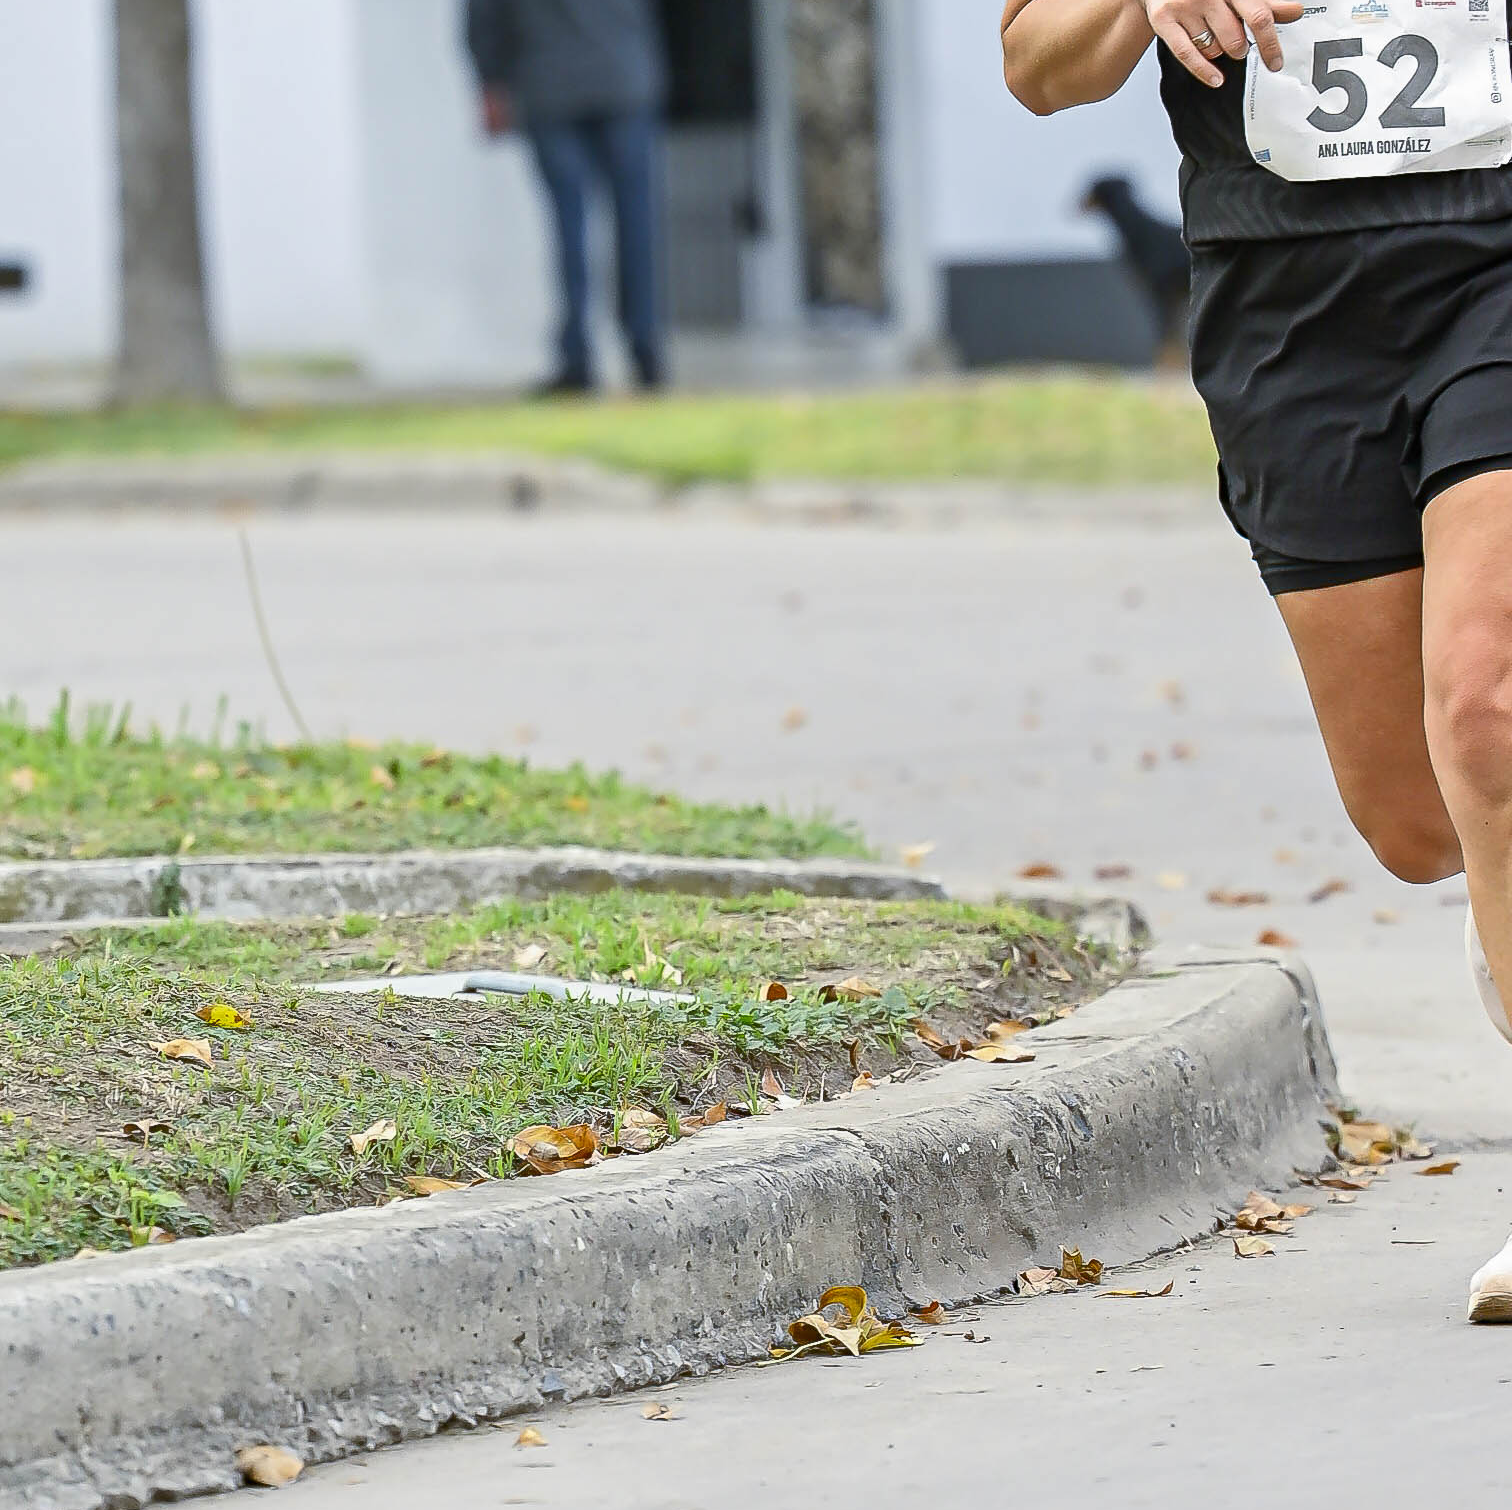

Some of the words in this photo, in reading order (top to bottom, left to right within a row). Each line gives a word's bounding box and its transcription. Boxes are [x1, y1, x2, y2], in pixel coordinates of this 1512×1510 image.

[1306, 34, 1446, 133] 52
[1318, 144, 1339, 159] ANA
[1340, 141, 1375, 157] LAURA
[1376, 136, 1432, 154] GONZÁLEZ
